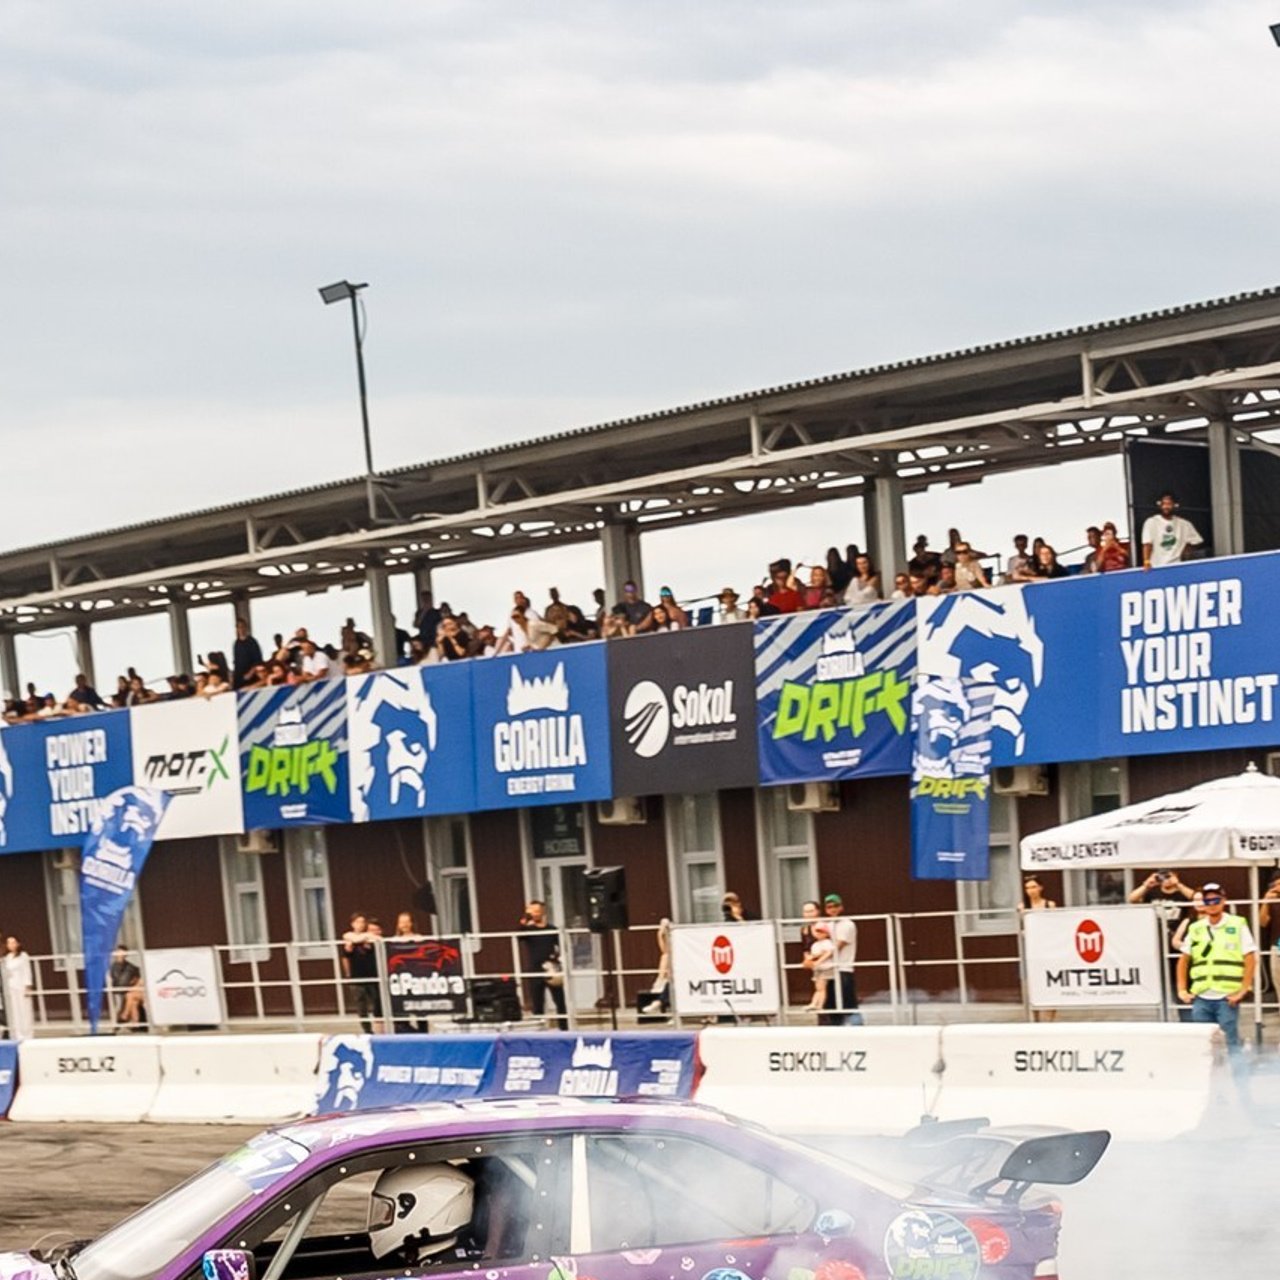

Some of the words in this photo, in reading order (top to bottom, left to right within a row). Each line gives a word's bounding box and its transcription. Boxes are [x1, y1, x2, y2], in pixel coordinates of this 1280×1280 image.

[1121, 579, 1242, 637] POWER
[816, 652, 864, 681] GORILLA
[1121, 632, 1211, 685] YOUR
[772, 667, 909, 741] DRIFT
[1121, 674, 1279, 734] INSTINCT
[46, 729, 107, 768] POWER
[494, 714, 587, 772] GORILLA
[48, 765, 94, 801] YOUR
[246, 740, 337, 797] DRIFT
[918, 776, 987, 801] DRIFT
[688, 978, 762, 996] MITSUJI
[1046, 968, 1141, 987] MITSUJI
[58, 1056, 115, 1073] SOKOL.KZ
[768, 1051, 867, 1073] SOKOL.KZ
[1014, 1050, 1126, 1073] SOKOL.KZ
[558, 1069, 619, 1097] GORILLA
